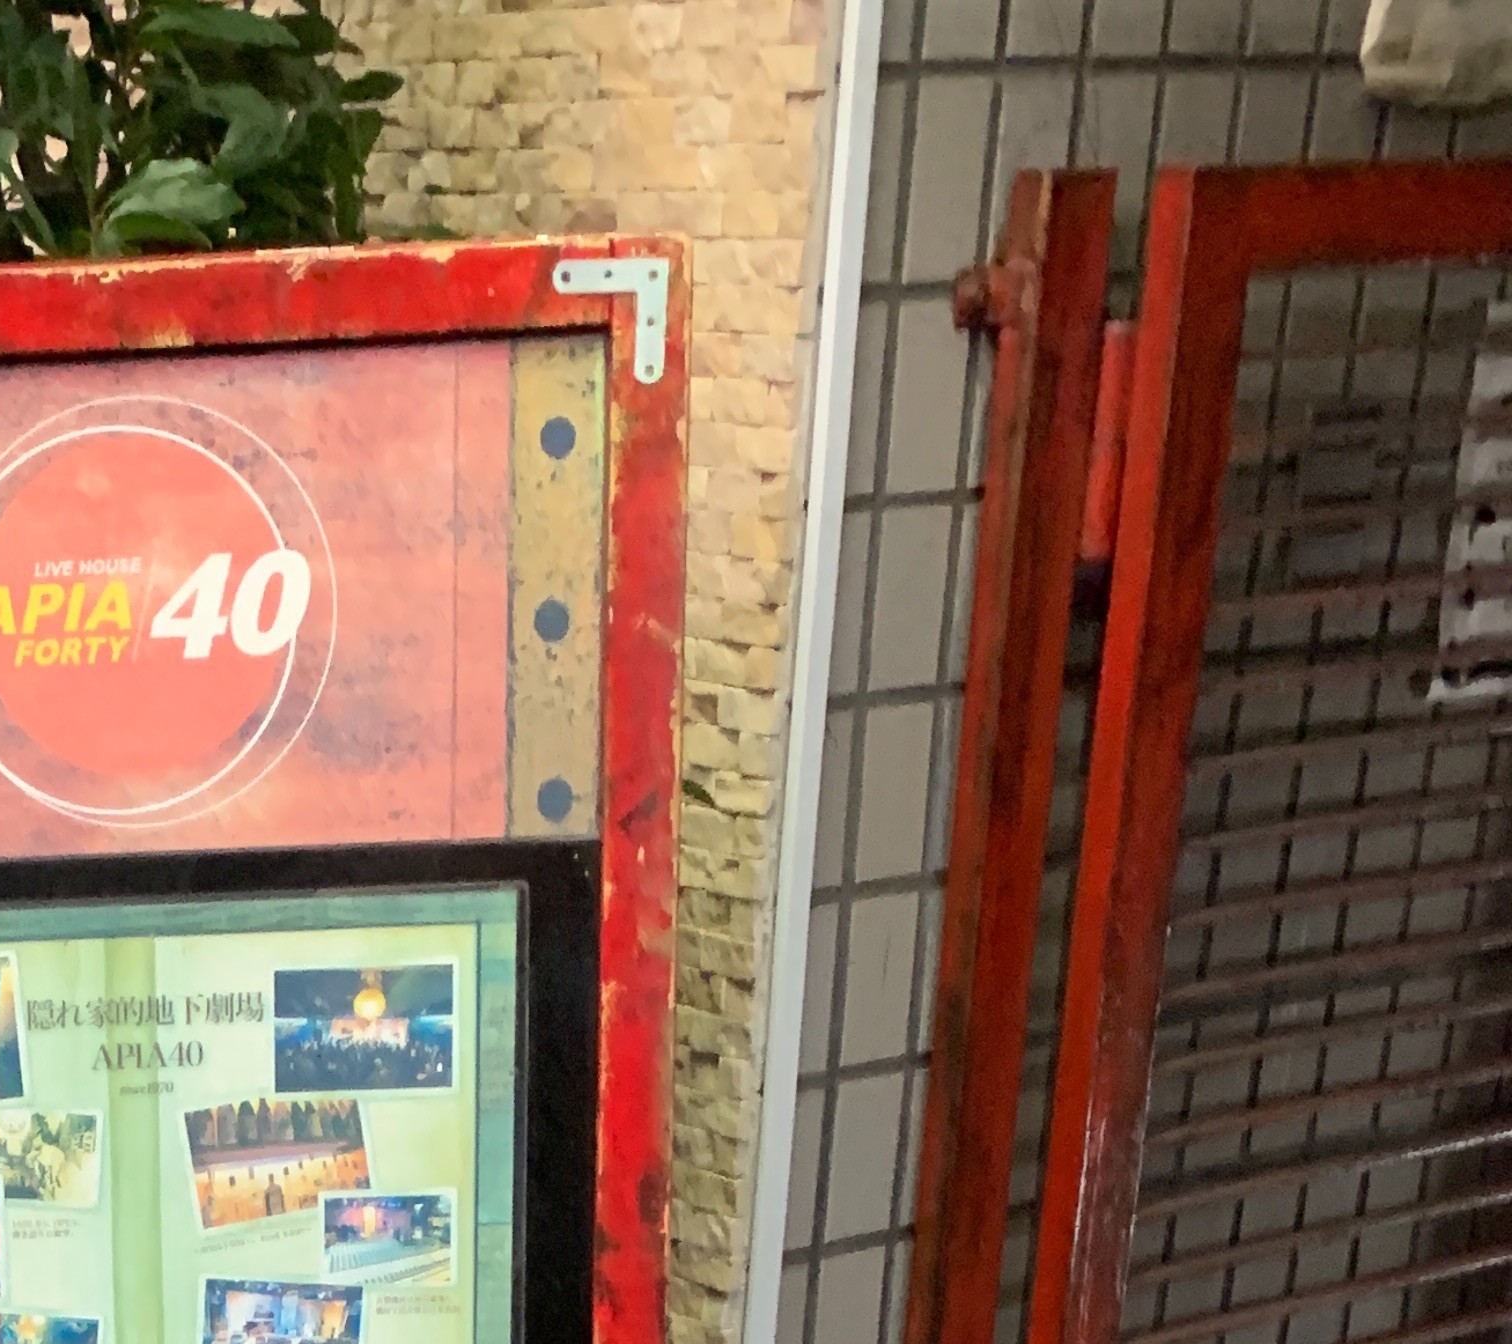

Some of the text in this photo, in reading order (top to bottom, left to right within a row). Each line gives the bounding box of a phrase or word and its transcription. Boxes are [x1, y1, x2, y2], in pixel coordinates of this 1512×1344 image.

[34, 556, 143, 579] LIVE HOUSE
[149, 549, 311, 660] 40
[14, 635, 131, 668] FORTY
[91, 1040, 204, 1072] APIA40
